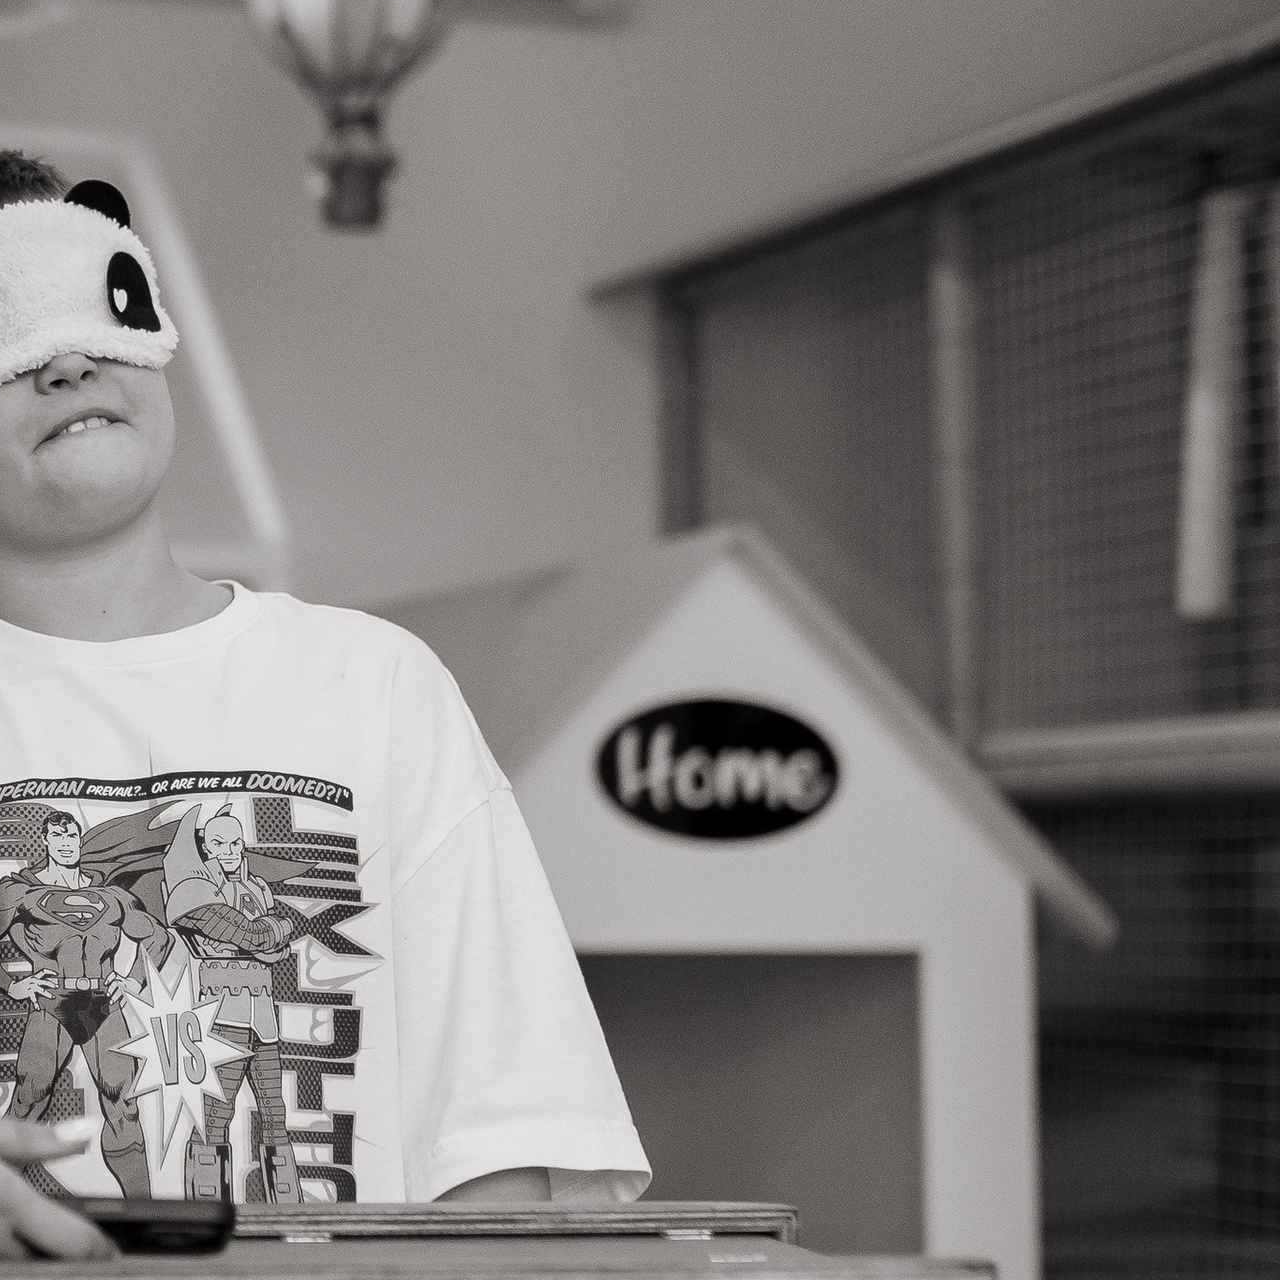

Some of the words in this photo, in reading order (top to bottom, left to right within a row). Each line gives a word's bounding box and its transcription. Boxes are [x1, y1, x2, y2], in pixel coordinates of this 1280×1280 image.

[86, 785, 147, 798] PREVAIL?...
[151, 780, 169, 794] OR
[170, 777, 195, 791] ARE
[197, 777, 220, 789] WE
[222, 776, 243, 788] ALL
[245, 773, 350, 803] DOOMED?!"
[617, 720, 834, 812] Home
[149, 1010, 207, 1086] VS
